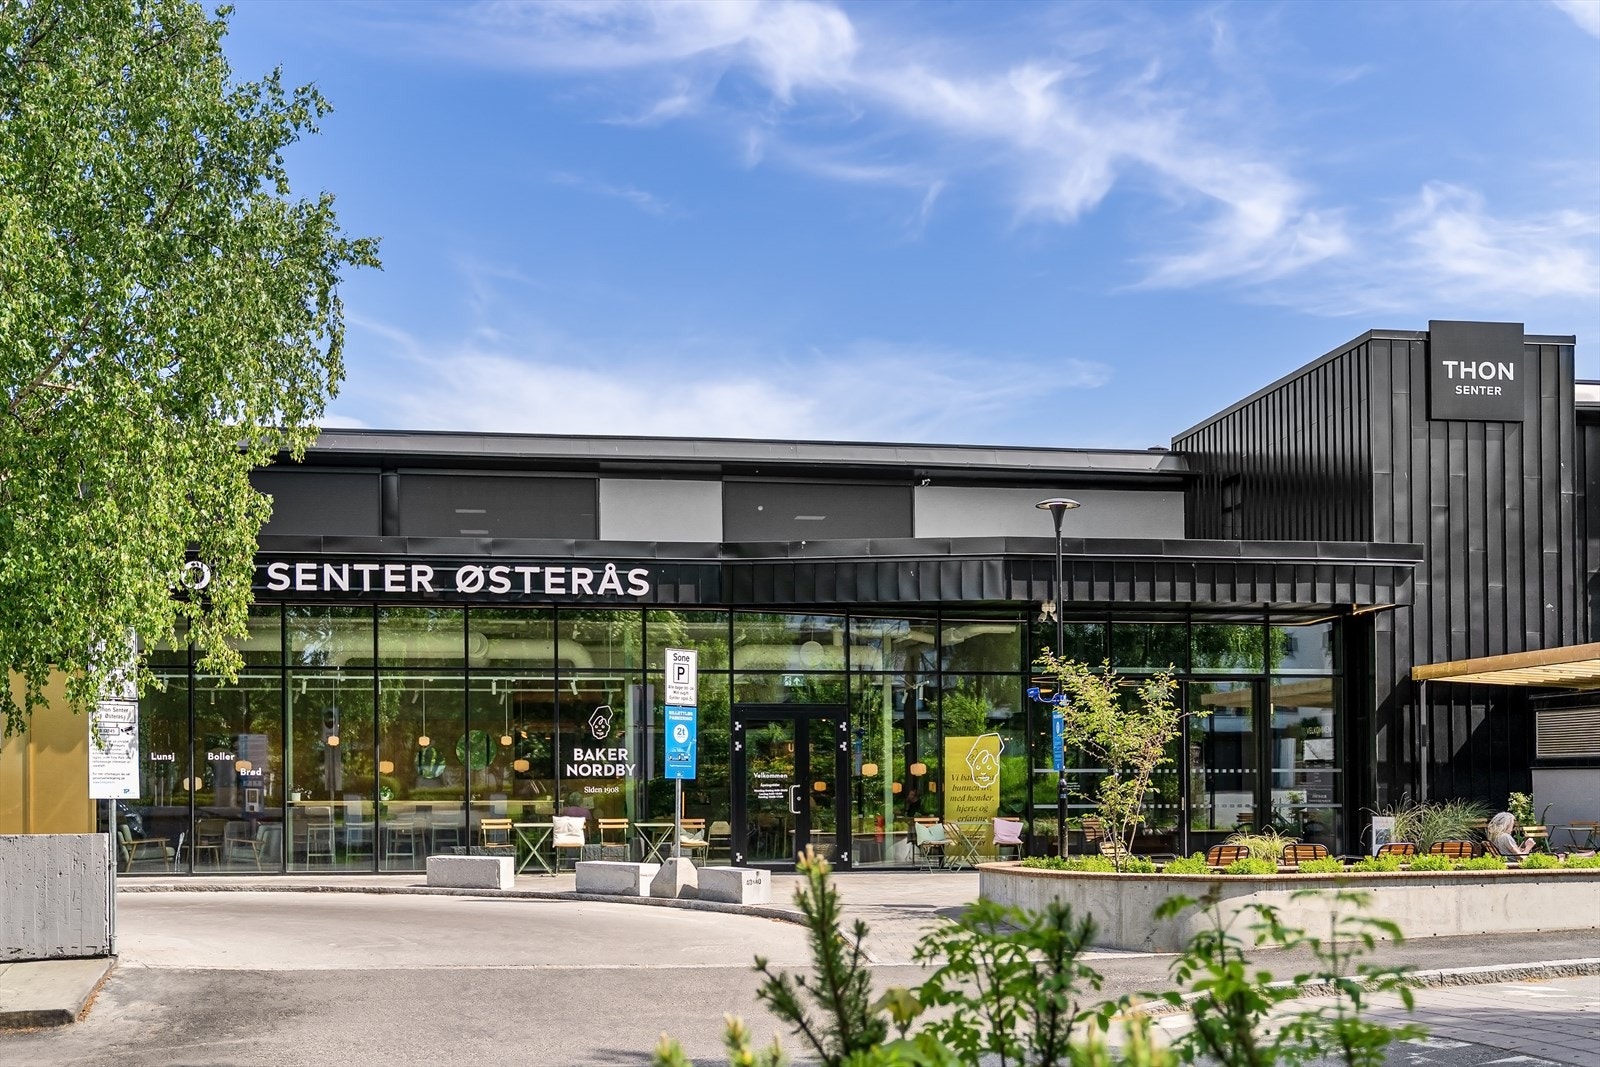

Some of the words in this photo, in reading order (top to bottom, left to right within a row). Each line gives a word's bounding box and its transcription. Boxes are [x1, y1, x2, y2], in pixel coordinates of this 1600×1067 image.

[1442, 360, 1514, 380] THON
[1455, 385, 1502, 396] SENTER
[266, 561, 434, 593] SENTER
[455, 562, 650, 596] ØSTERÅS
[673, 653, 690, 662] Sone
[677, 666, 685, 680] P
[677, 727, 685, 735] 2t
[150, 752, 175, 762] Lunsj
[207, 752, 235, 761] Boller
[573, 748, 629, 761] BAKER
[240, 767, 262, 776] Brød
[566, 763, 636, 777] NORDBY
[952, 784, 980, 792] bunnen
[950, 794, 965, 802] med
[956, 804, 978, 812] hjerte
